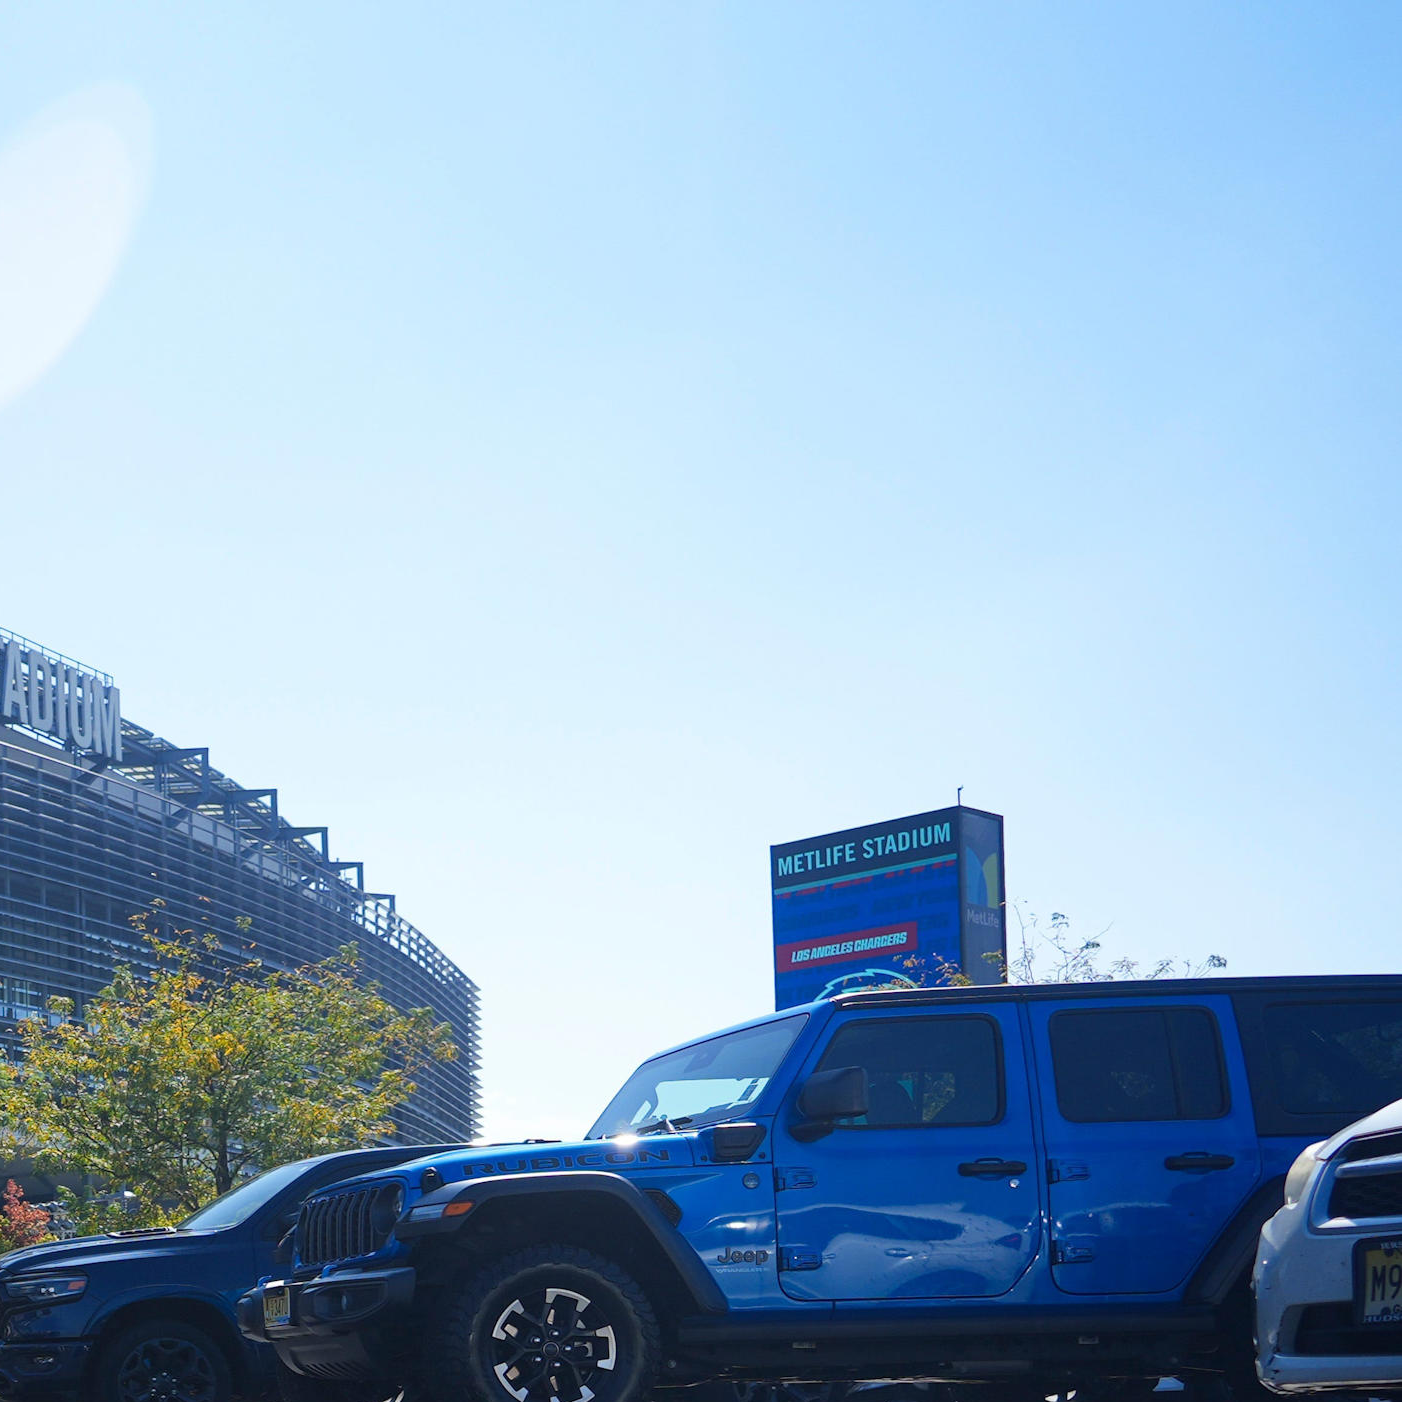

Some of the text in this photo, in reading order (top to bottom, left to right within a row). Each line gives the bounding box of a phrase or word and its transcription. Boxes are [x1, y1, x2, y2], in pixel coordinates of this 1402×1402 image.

[777, 843, 857, 877] METLIFE
[862, 822, 951, 859] STADIUM
[791, 931, 908, 963] LOS ANGELES CHARGERS
[462, 1150, 670, 1177] RUBICON
[717, 1246, 769, 1265] Jeep
